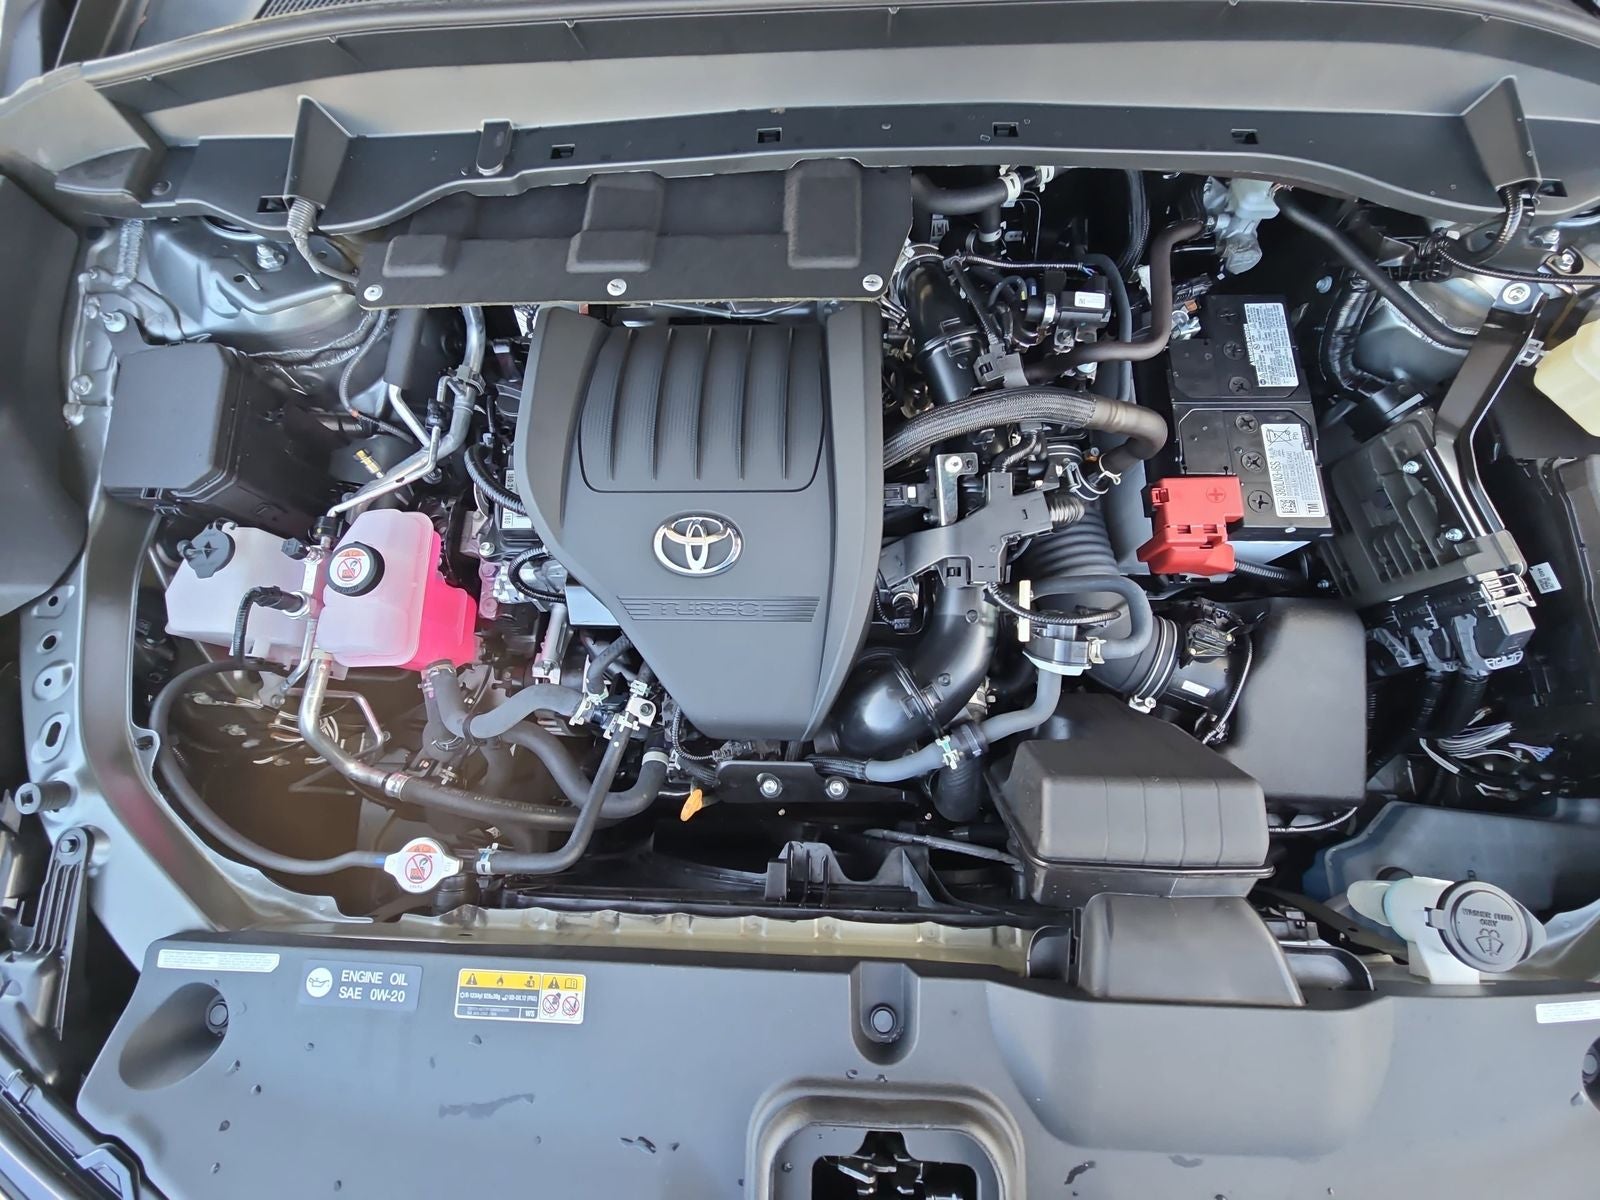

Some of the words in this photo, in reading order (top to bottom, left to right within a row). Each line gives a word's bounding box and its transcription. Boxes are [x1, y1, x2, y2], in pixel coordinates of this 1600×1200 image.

[1306, 503, 1320, 514] TM
[652, 602, 760, 616] TURBO
[341, 969, 383, 985] ENGINE
[389, 972, 408, 986] OIL
[338, 986, 362, 1000] SAE
[370, 988, 406, 1003] 0W-20
